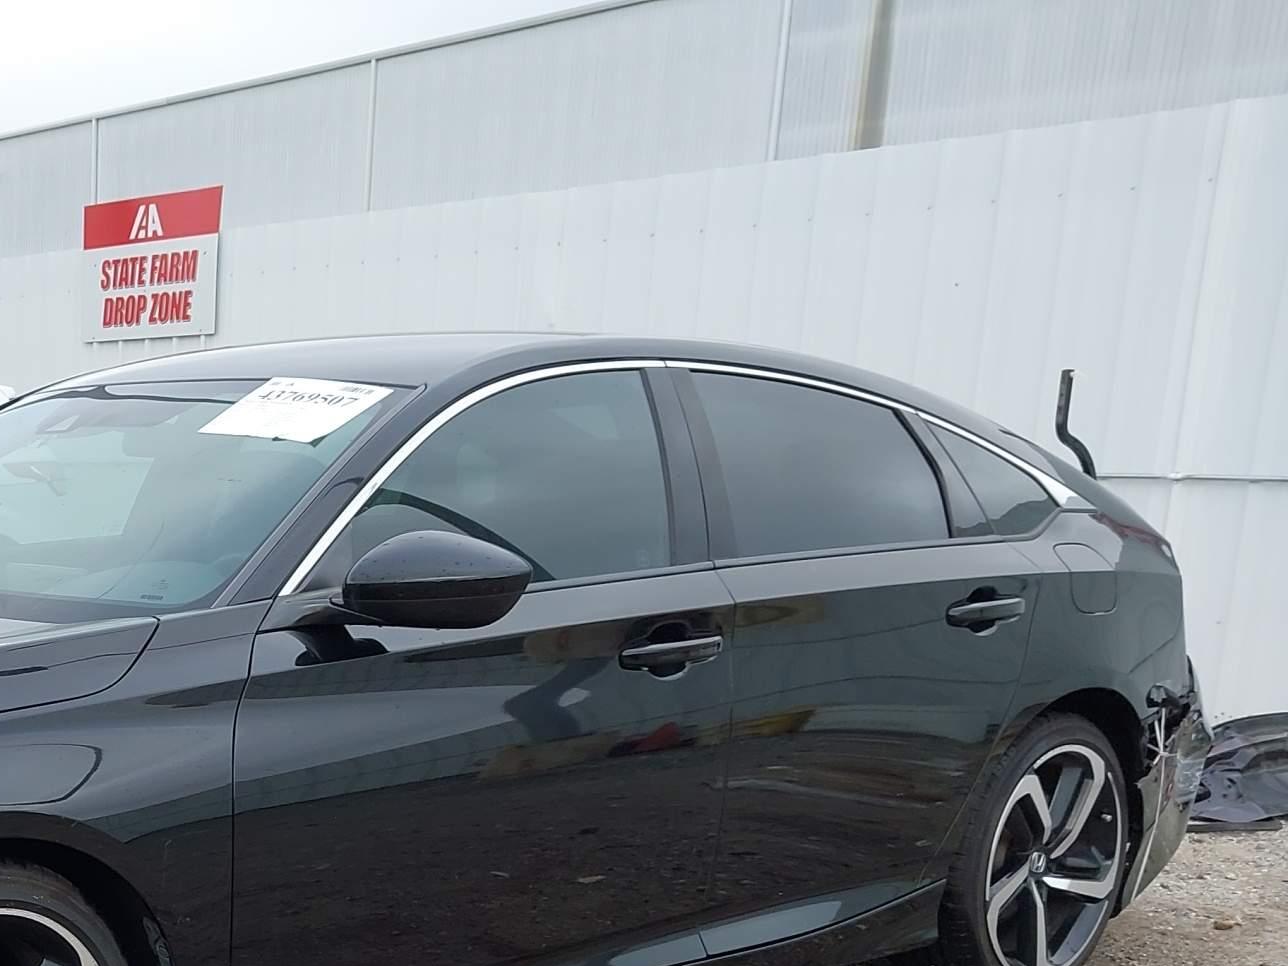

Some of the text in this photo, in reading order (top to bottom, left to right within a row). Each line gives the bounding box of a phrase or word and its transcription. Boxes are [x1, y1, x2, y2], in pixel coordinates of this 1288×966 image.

[100, 249, 199, 291] STATE FARM
[103, 289, 193, 328] DROP ZONE
